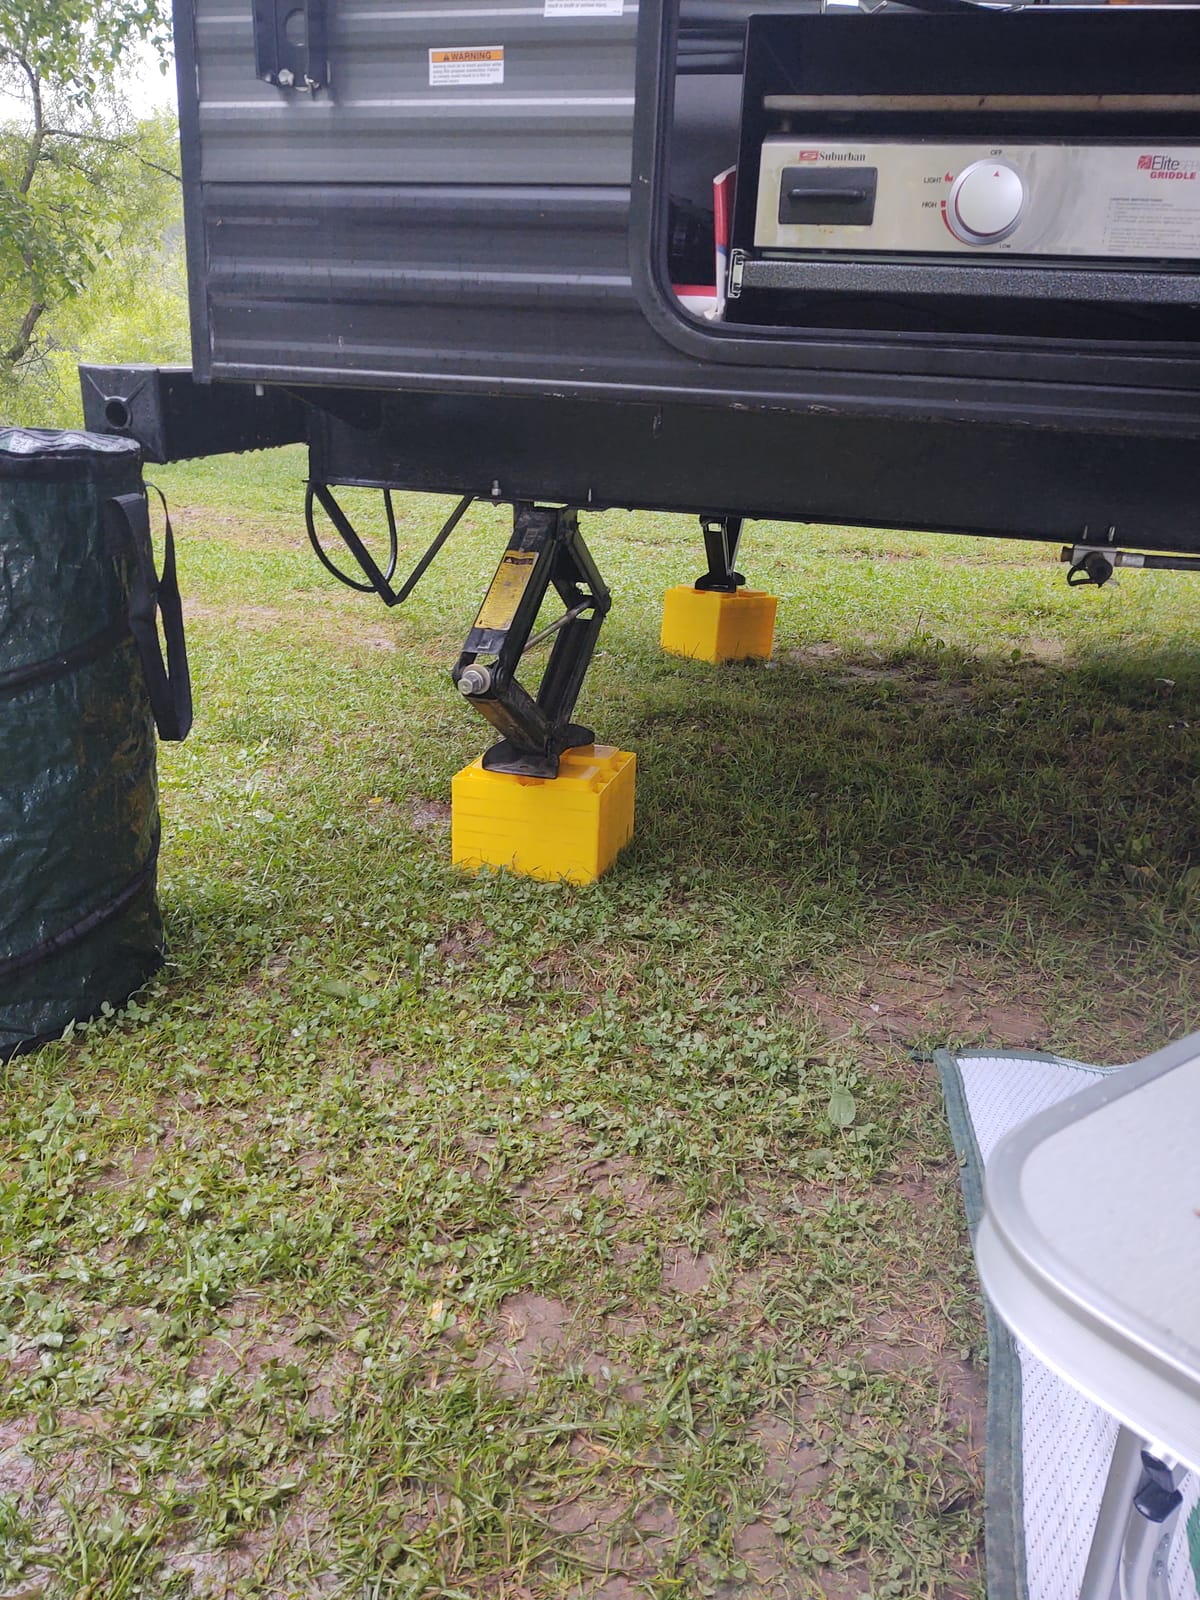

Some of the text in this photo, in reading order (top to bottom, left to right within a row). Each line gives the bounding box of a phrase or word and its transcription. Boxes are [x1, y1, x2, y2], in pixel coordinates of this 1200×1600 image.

[450, 51, 492, 61] WARNING
[820, 151, 866, 161] Suburban
[1152, 155, 1181, 171] Elite
[1150, 171, 1197, 180] GRIDDLE
